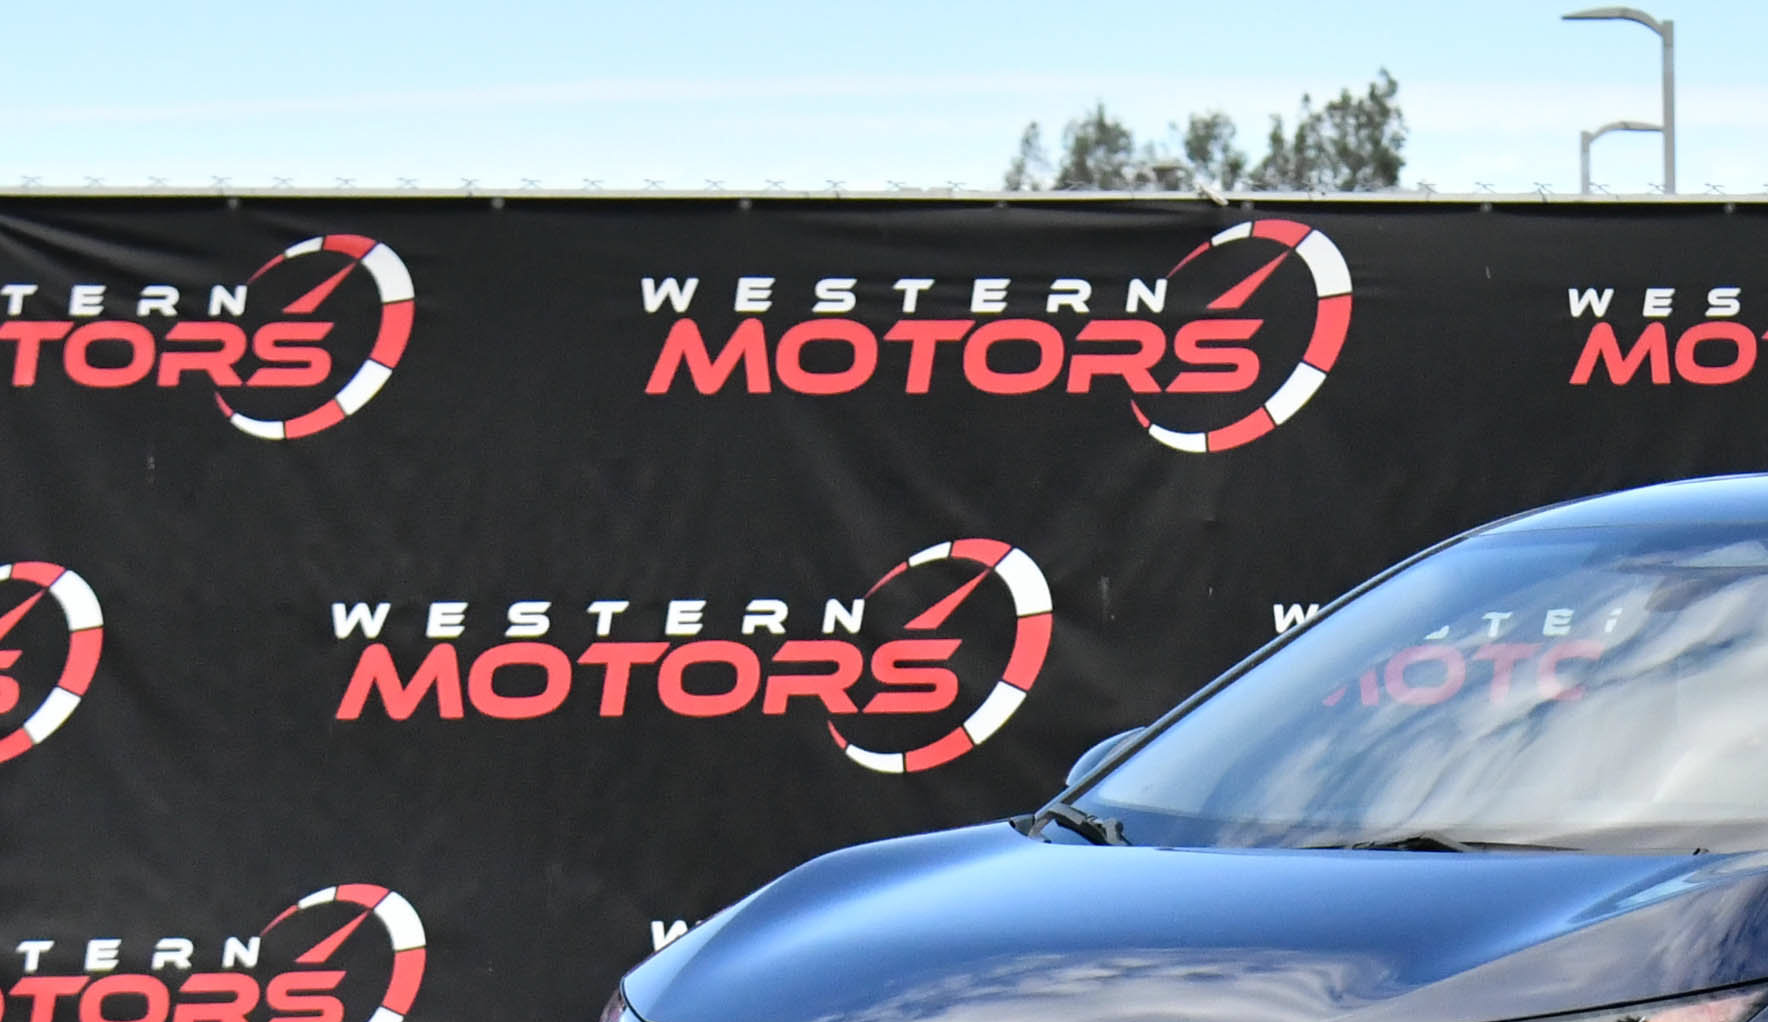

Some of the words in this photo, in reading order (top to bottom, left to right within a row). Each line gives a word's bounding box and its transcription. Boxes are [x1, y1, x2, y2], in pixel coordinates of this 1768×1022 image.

[0, 285, 248, 317] TERN
[641, 278, 1168, 313] WESTERN
[0, 320, 334, 389] TORS
[645, 318, 1264, 396] MOTORS
[331, 599, 866, 639] WESTERN
[335, 639, 963, 721] MOTORS
[15, 937, 262, 974] TERN
